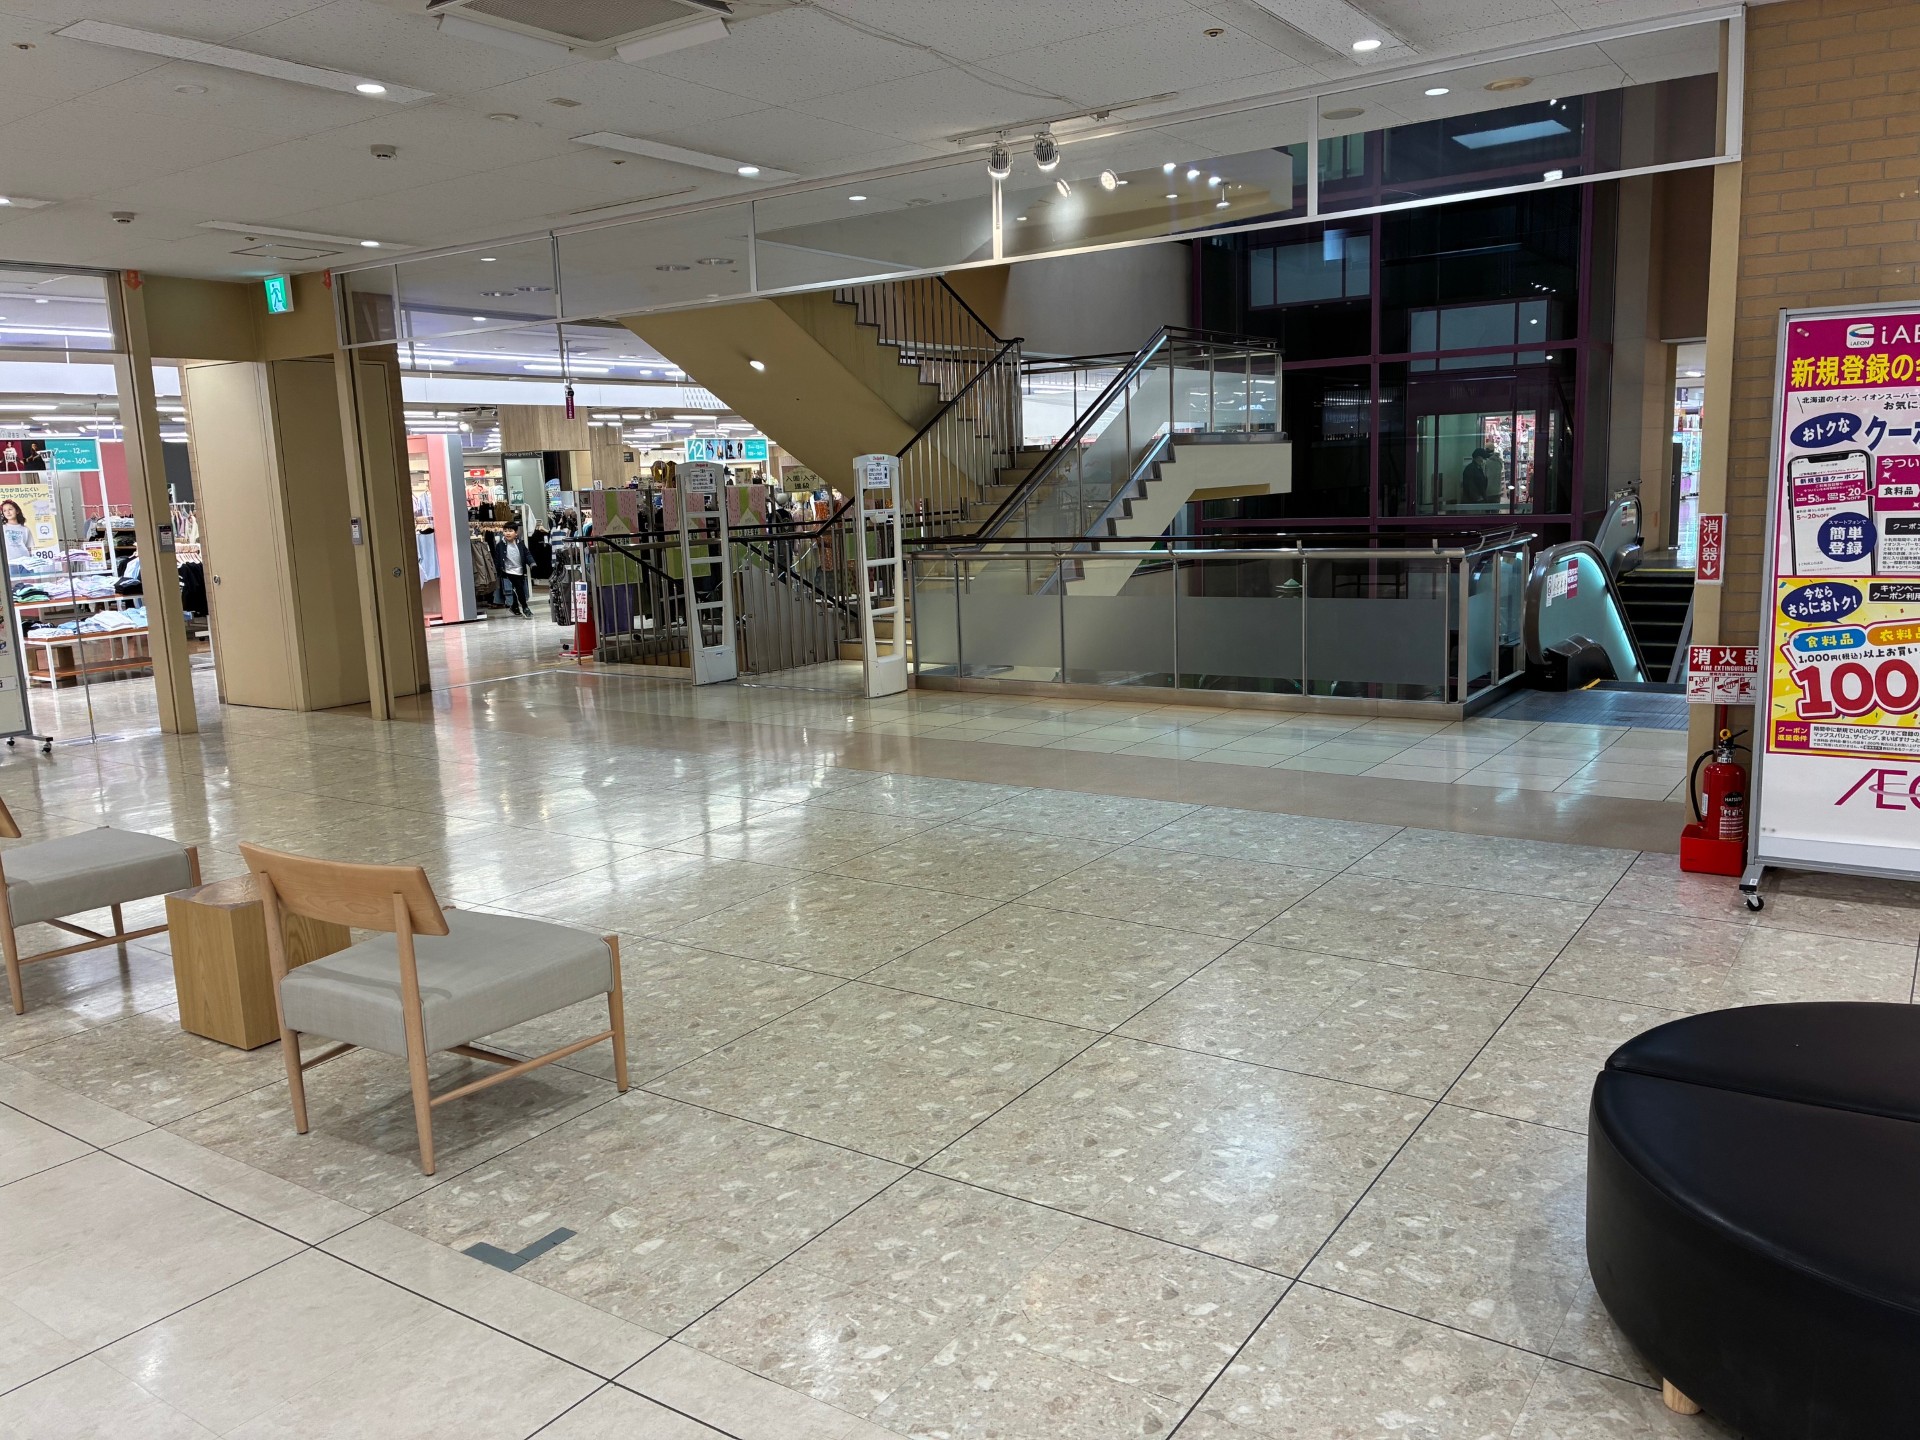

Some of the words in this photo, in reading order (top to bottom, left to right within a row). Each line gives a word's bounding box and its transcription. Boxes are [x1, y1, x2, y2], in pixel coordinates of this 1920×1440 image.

[1791, 353, 1920, 388] 新規登録の
[1802, 392, 1920, 404] 北海道のイオン、イオンスーパー
[1883, 401, 1920, 410] お気に
[1802, 418, 1851, 442] おトクな
[1864, 415, 1920, 452] クー
[1800, 473, 1859, 484] 新規登録クーポン
[1884, 486, 1914, 496] 食料品
[1702, 520, 1718, 560] 消火器
[1830, 526, 1863, 540] 簡単
[1828, 542, 1862, 555] 登録
[1804, 586, 1833, 600] 今なら
[1805, 632, 1854, 648] 食料品
[1692, 648, 1758, 666] 消火器
[1778, 726, 1808, 734] クーポン
